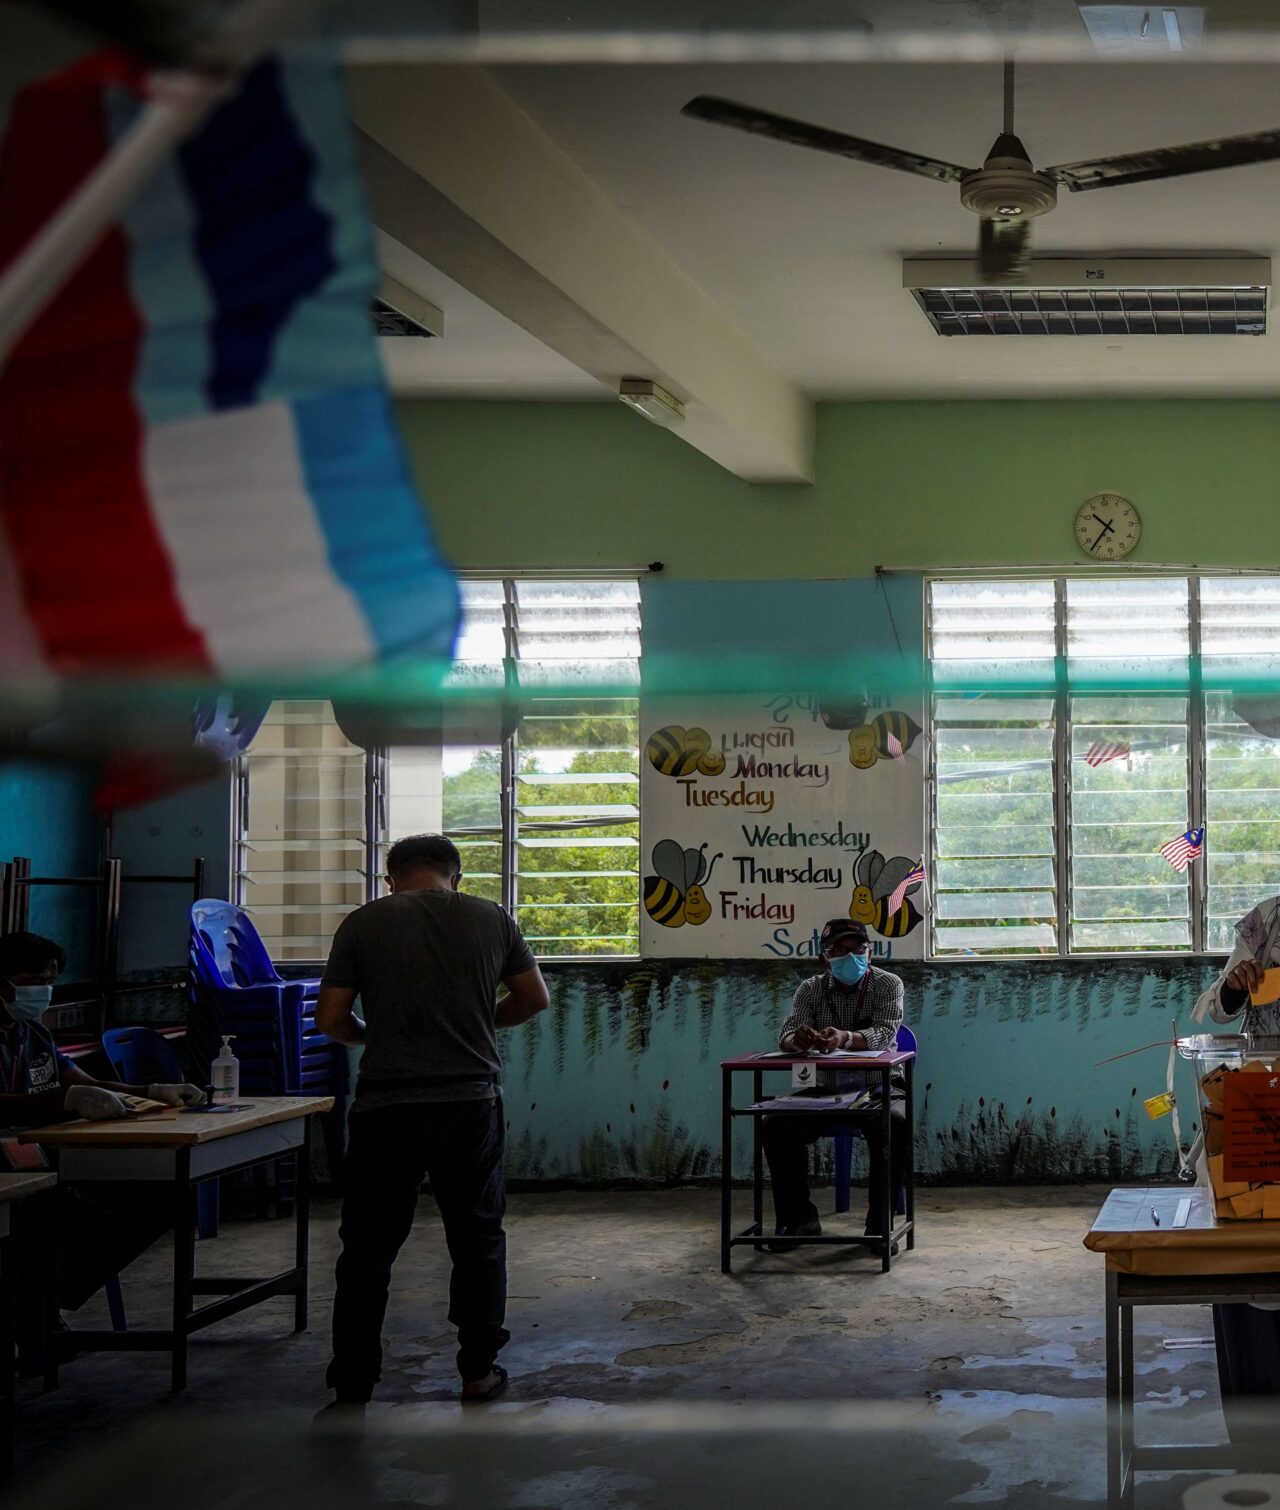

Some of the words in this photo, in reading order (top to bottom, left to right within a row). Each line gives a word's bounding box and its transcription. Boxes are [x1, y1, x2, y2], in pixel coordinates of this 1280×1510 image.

[730, 753, 830, 788] Monday
[675, 779, 775, 814] Tuesday
[741, 821, 871, 852] Wednesday
[732, 857, 843, 890] Thursday
[719, 891, 795, 925] Friday
